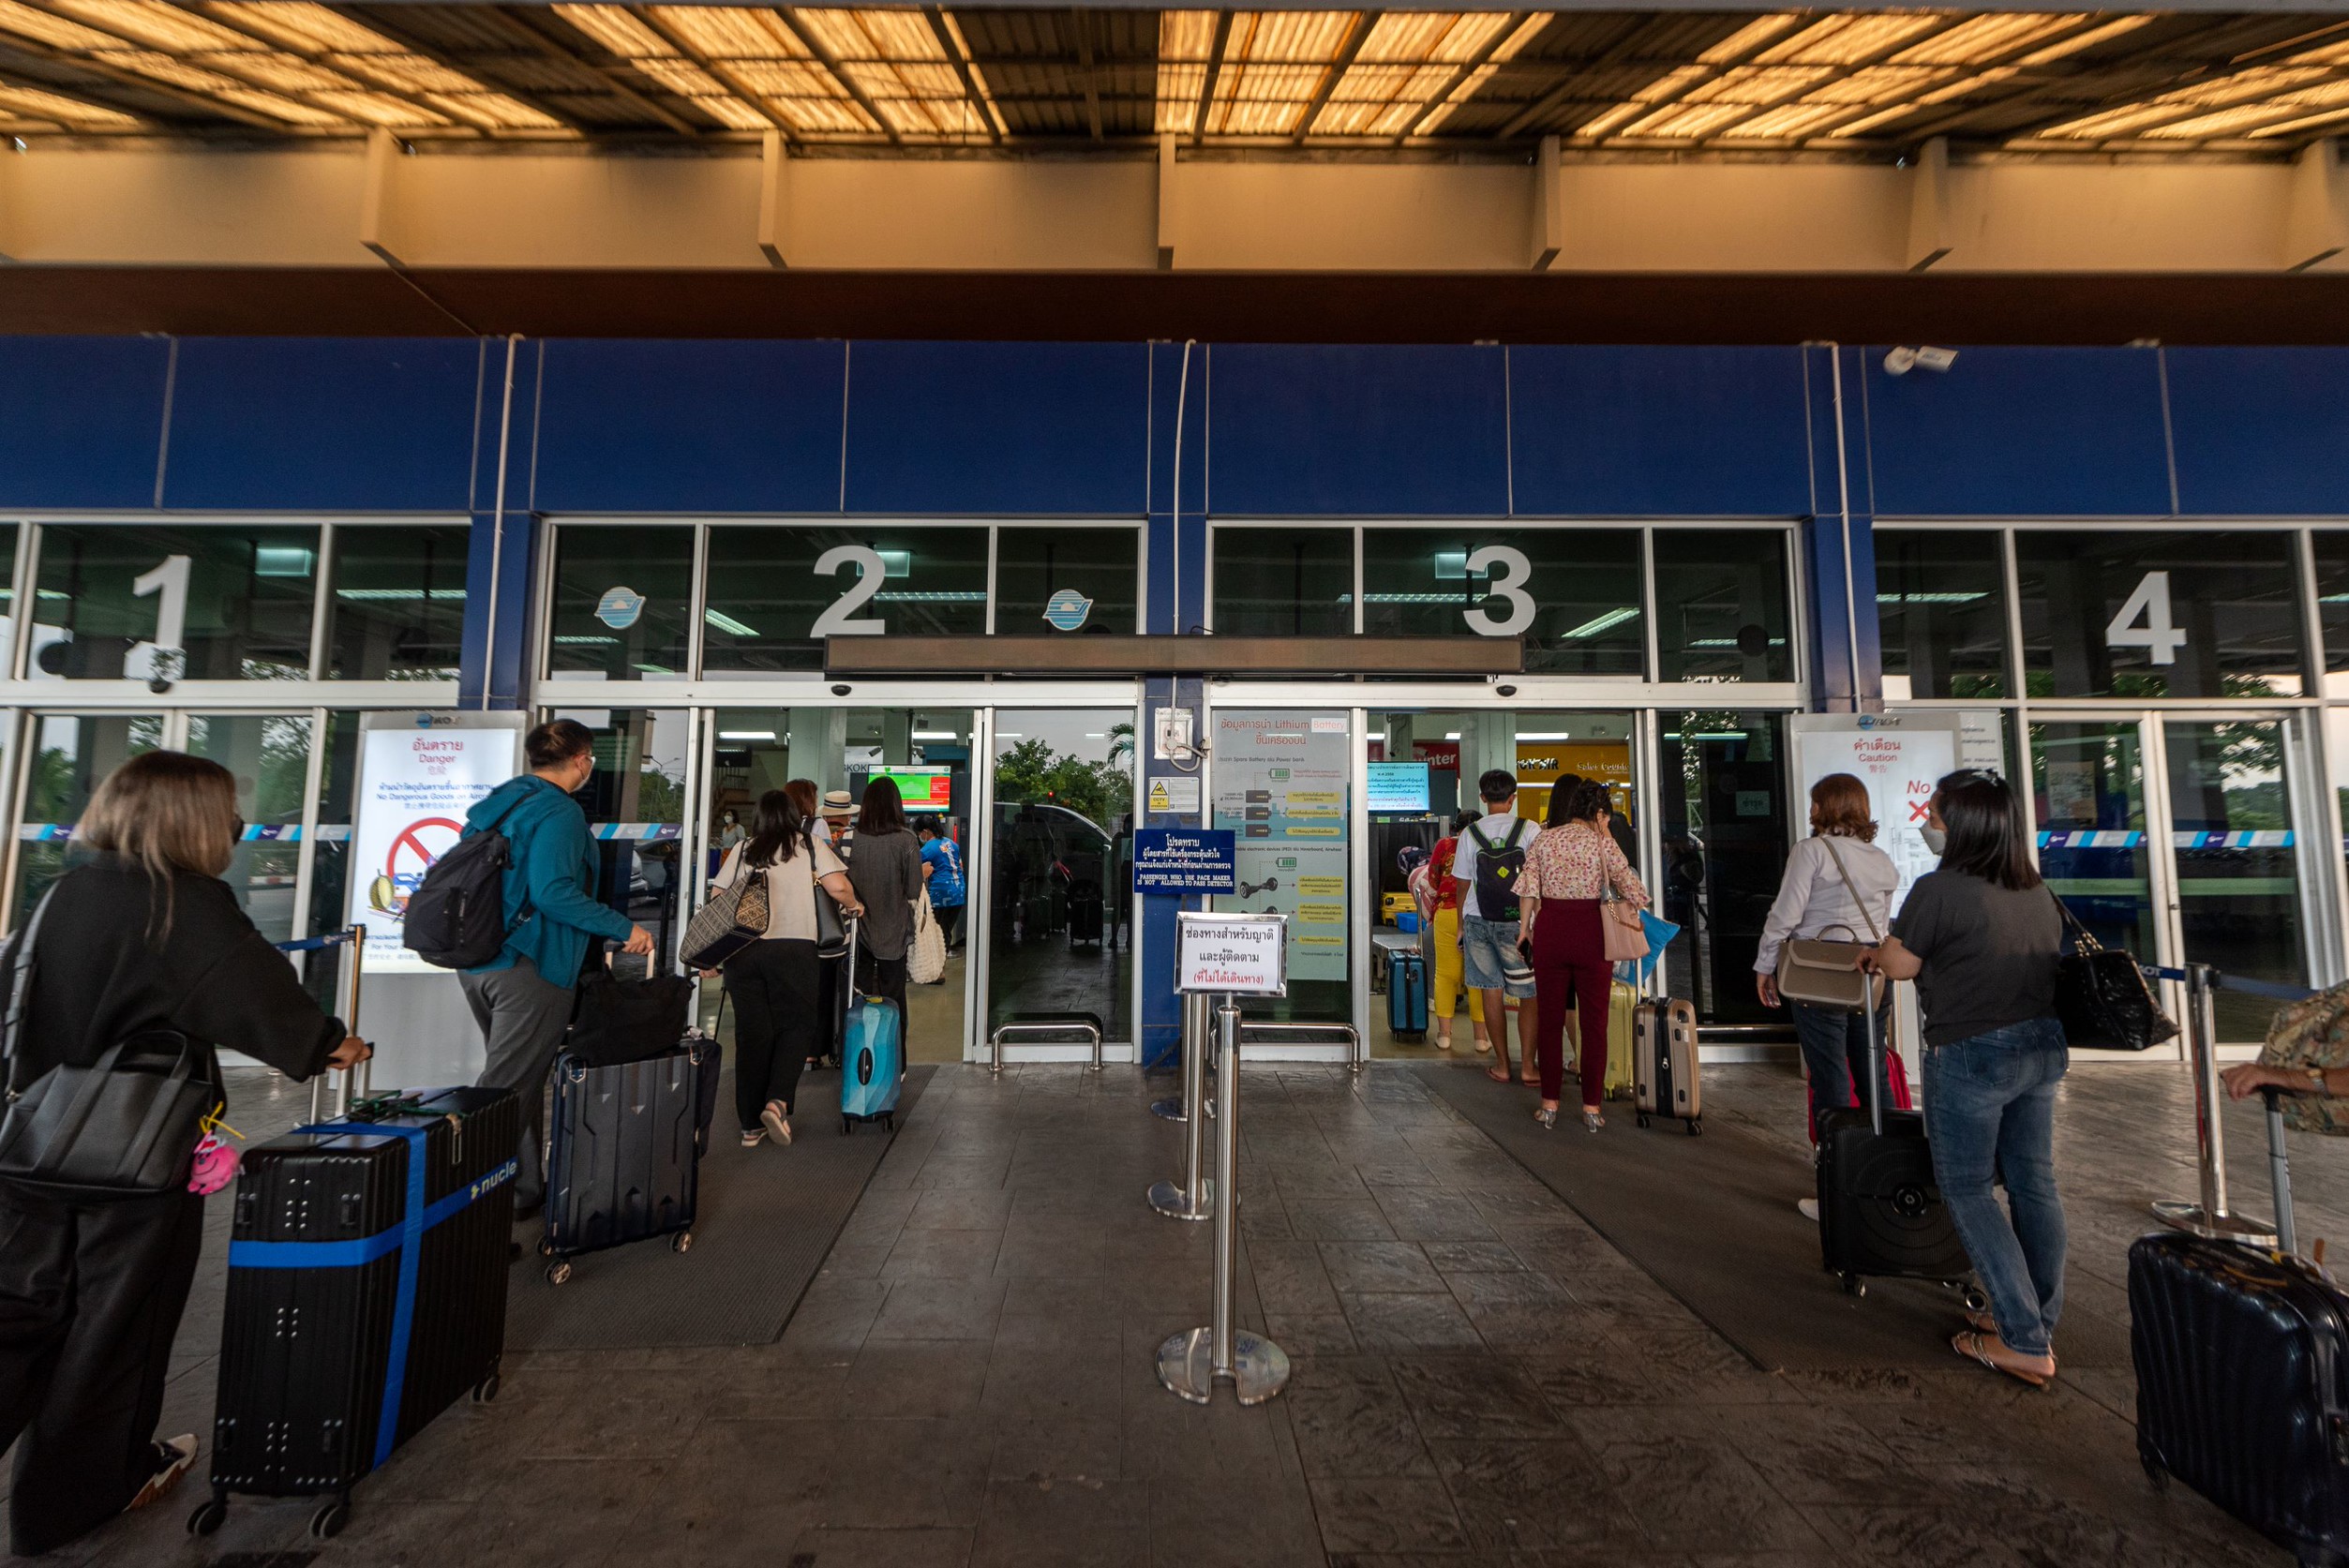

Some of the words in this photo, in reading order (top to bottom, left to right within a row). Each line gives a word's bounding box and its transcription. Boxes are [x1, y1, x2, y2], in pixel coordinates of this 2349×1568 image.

[810, 545, 886, 637] 2
[1463, 545, 1536, 636] 3
[133, 555, 192, 650] 1
[2105, 571, 2186, 665] 4
[1221, 718, 1271, 731] ข้อมูลการนำ
[1275, 720, 1309, 729] Lithium
[1313, 720, 1344, 730] Battery
[412, 737, 464, 751] อันตราย
[1853, 738, 1901, 751] คำเตือน
[419, 754, 456, 765] Danger
[1424, 754, 1457, 765] nter
[1859, 754, 1897, 762] Caution
[1907, 780, 1931, 794] No
[1166, 833, 1200, 846] โปรดทราบ
[1186, 926, 1274, 943] ช่องทางสำหรับญาติ
[1193, 967, 1264, 985] (ที่ไม่ได้เดินทาง)
